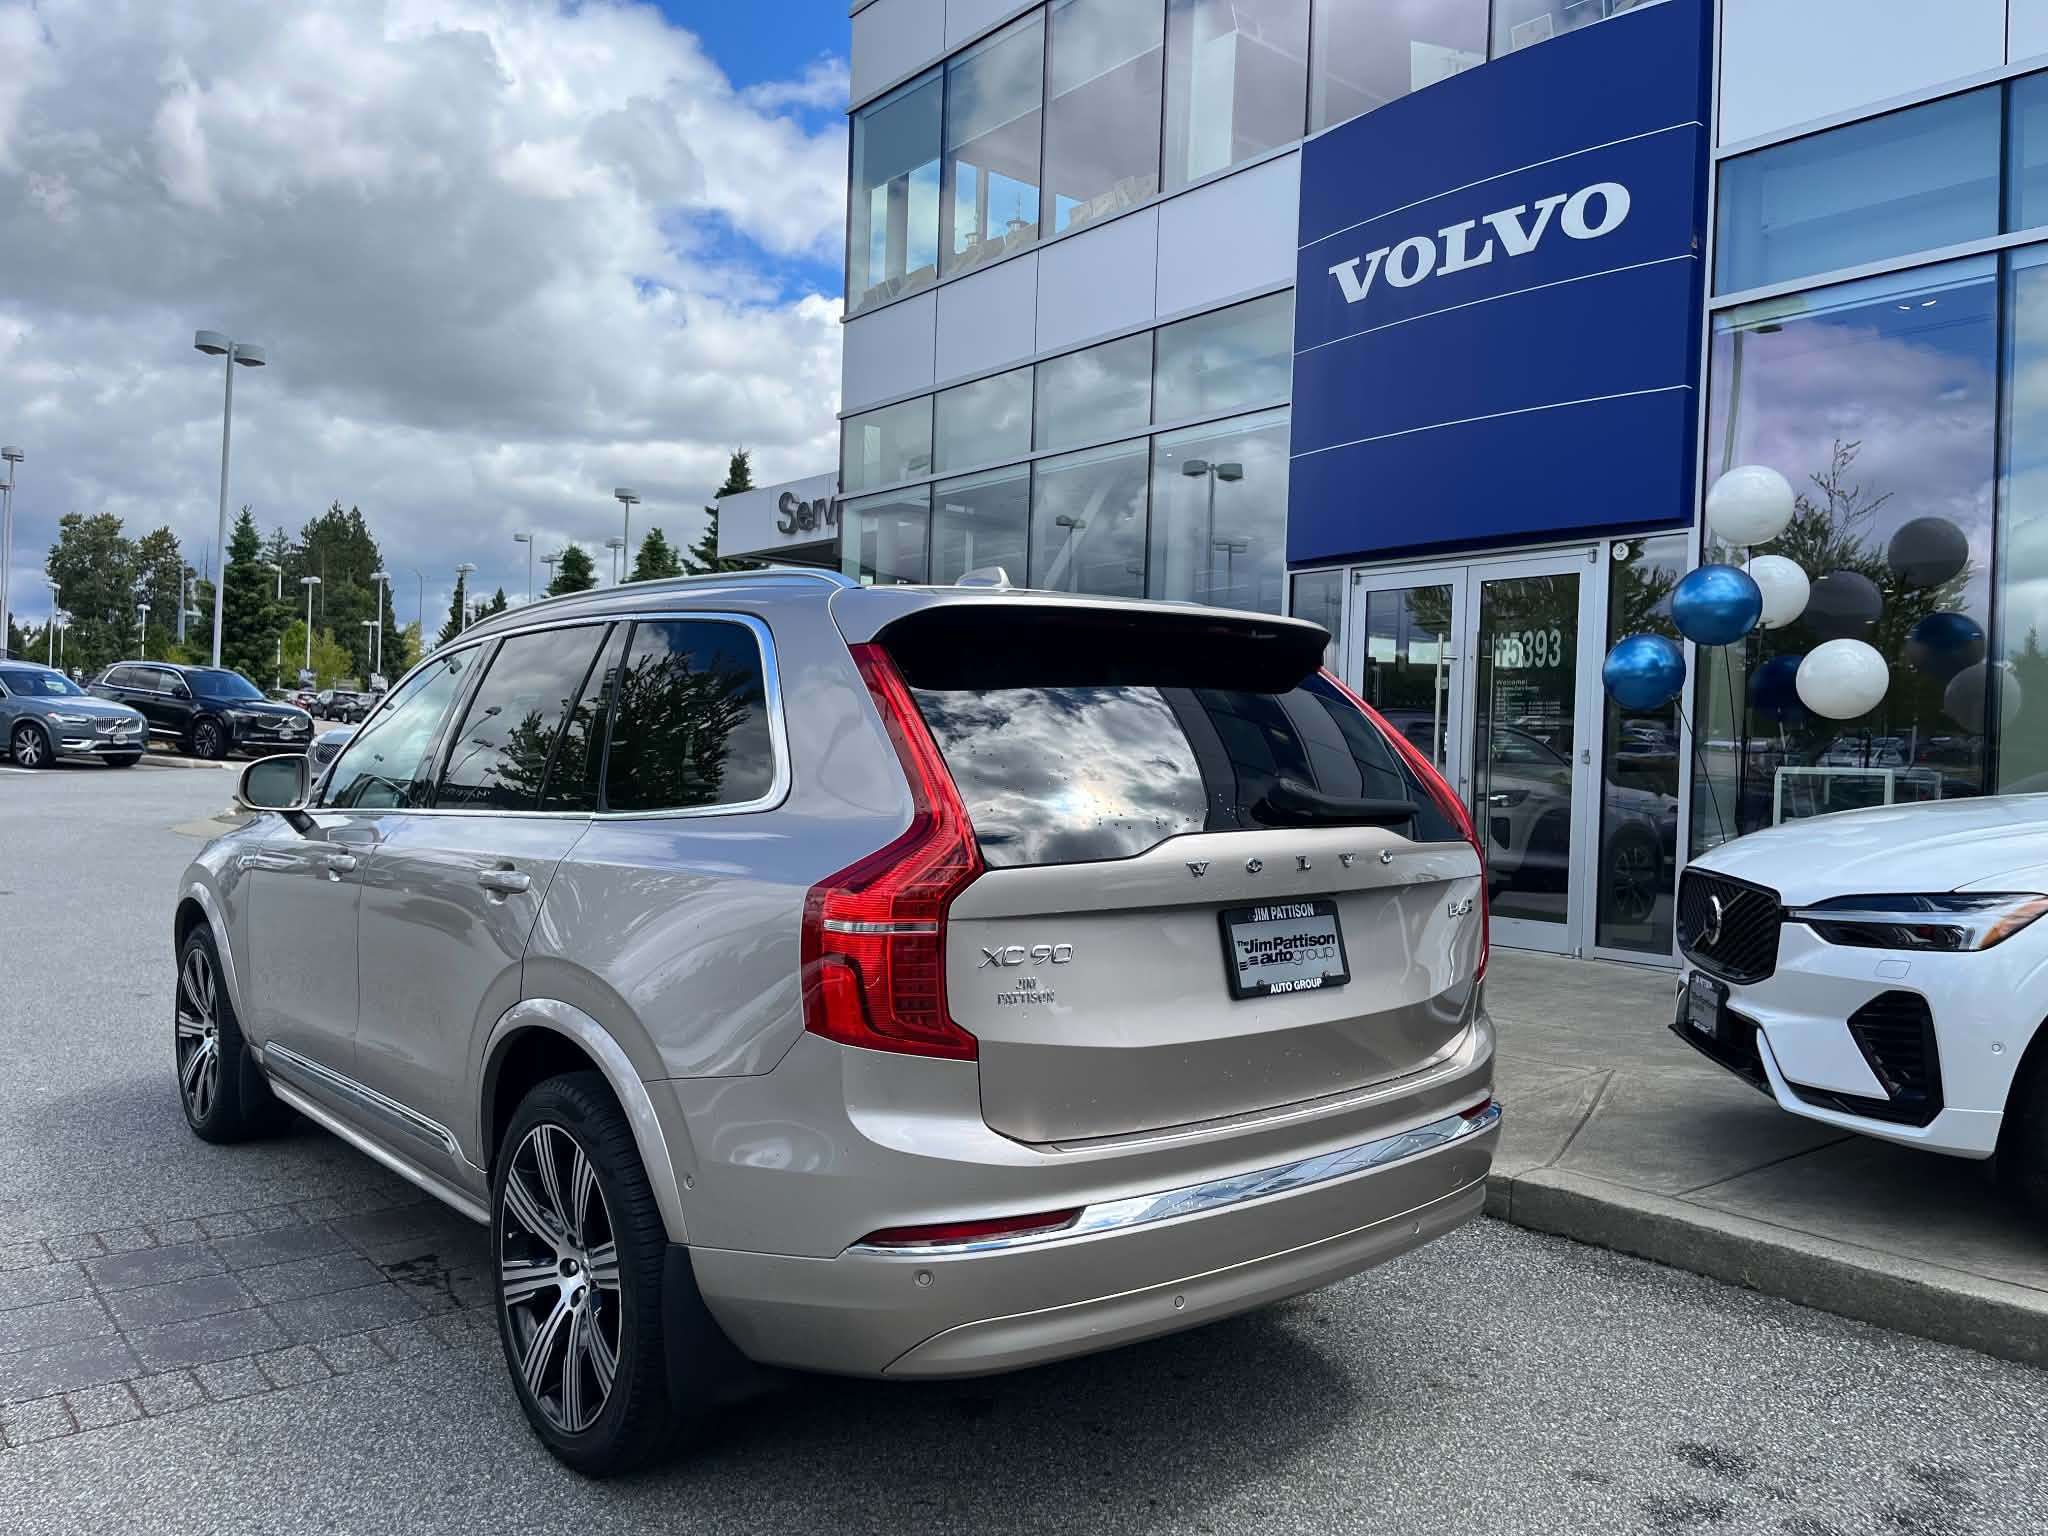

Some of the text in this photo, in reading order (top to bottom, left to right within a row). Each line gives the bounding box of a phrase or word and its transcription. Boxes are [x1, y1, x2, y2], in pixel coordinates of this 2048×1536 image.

[1328, 182, 1631, 304] VOLVO
[1186, 850, 1393, 878] VOLVO
[1254, 903, 1315, 922] JIM PATTISON
[1016, 976, 1037, 990] JIM
[1270, 977, 1322, 994] AUTO GROUP
[997, 989, 1055, 1006] PATTISON
